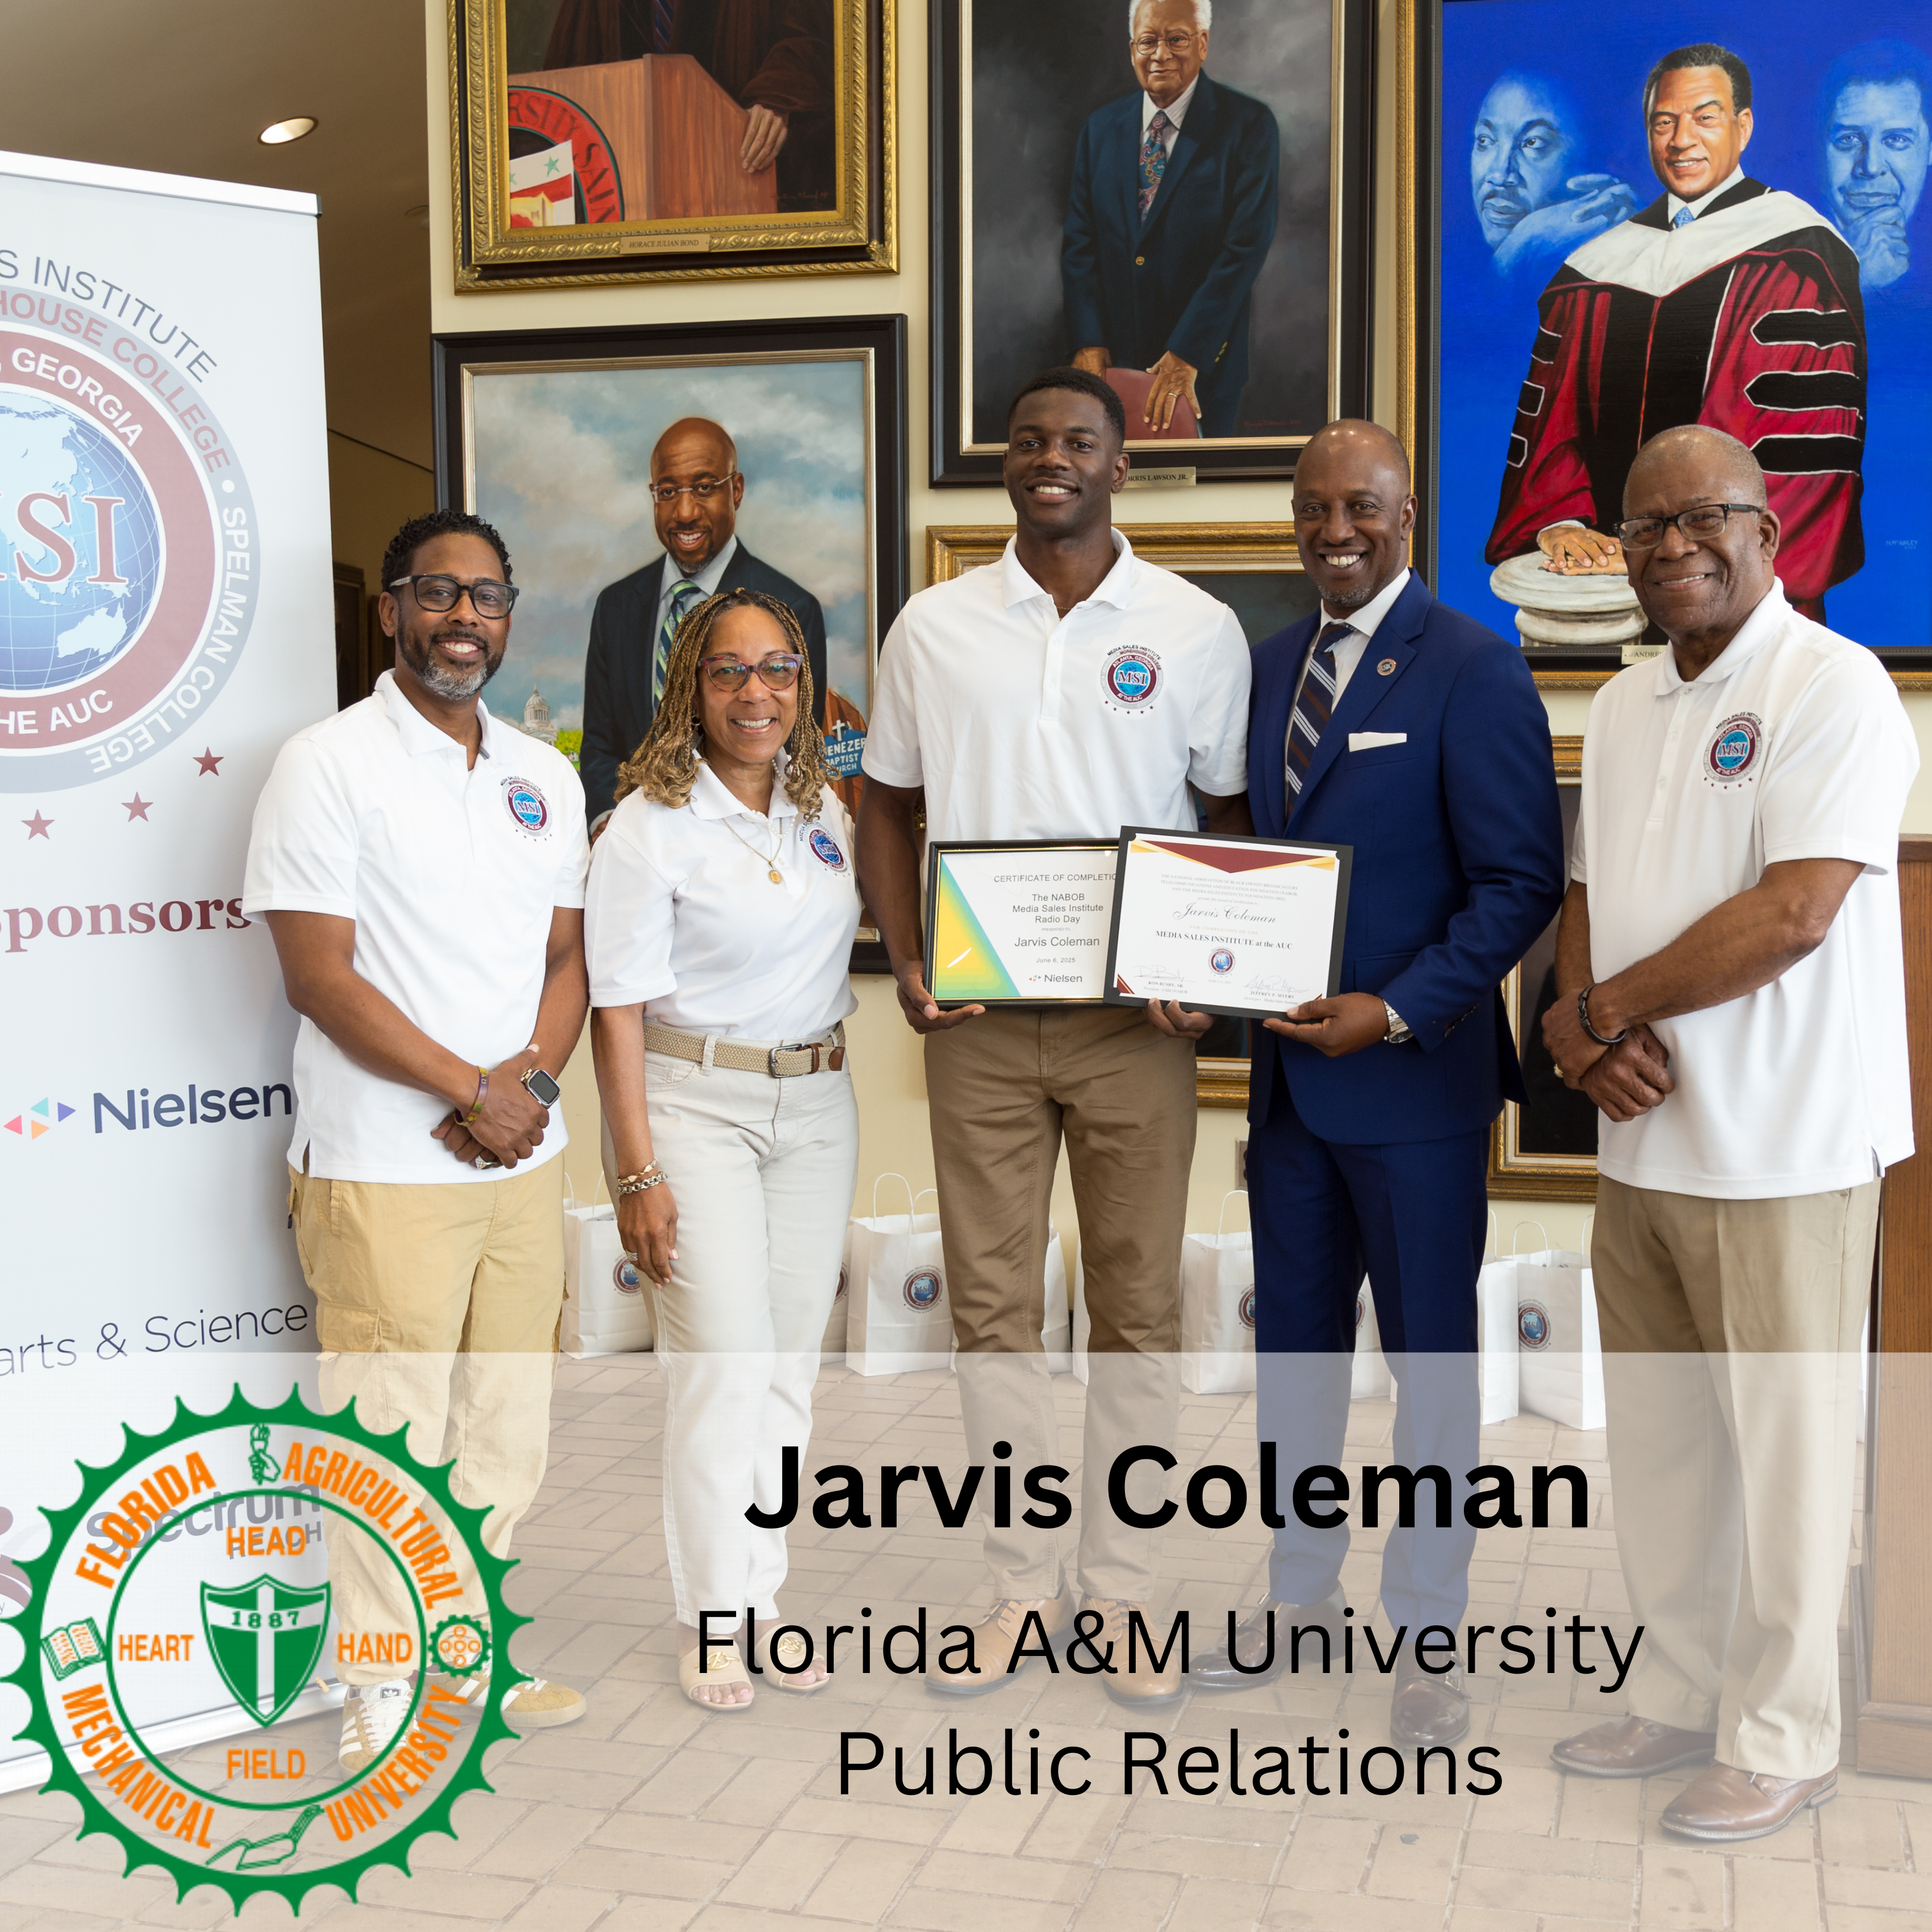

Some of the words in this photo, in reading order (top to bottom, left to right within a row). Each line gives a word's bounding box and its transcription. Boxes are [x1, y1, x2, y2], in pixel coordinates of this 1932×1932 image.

[34, 257, 218, 383] INSTITUTE
[11, 347, 143, 447] GEORGIA
[113, 338, 231, 473] COLLEGE
[0, 492, 128, 584] SI
[205, 507, 250, 664] SPELMAN
[1107, 647, 1122, 656] MEDIA
[1140, 646, 1161, 660] INSTITUTE
[1135, 656, 1154, 671] GEORGIA
[1118, 670, 1147, 685] MSI
[50, 689, 113, 732] AUC
[85, 665, 215, 773] COLLEGE
[826, 738, 866, 756] ENEZER
[1719, 742, 1747, 756] MSI
[516, 801, 540, 815] MSI
[1161, 880, 1212, 888] TELECOMMUNICATIONS
[1063, 915, 1080, 924] Day
[1173, 902, 1219, 920] Jarvis
[1224, 905, 1276, 923] Coleman
[0, 898, 252, 953] ponsors
[1014, 937, 1047, 946] Jarvis
[1051, 937, 1100, 946] Coleman
[1155, 930, 1182, 939] MEDIA
[1184, 933, 1209, 941] SALES
[1211, 936, 1254, 946] INSTITUTE
[94, 1083, 292, 1133] Nielsen
[96, 1323, 128, 1360] &
[146, 1305, 308, 1352] Science
